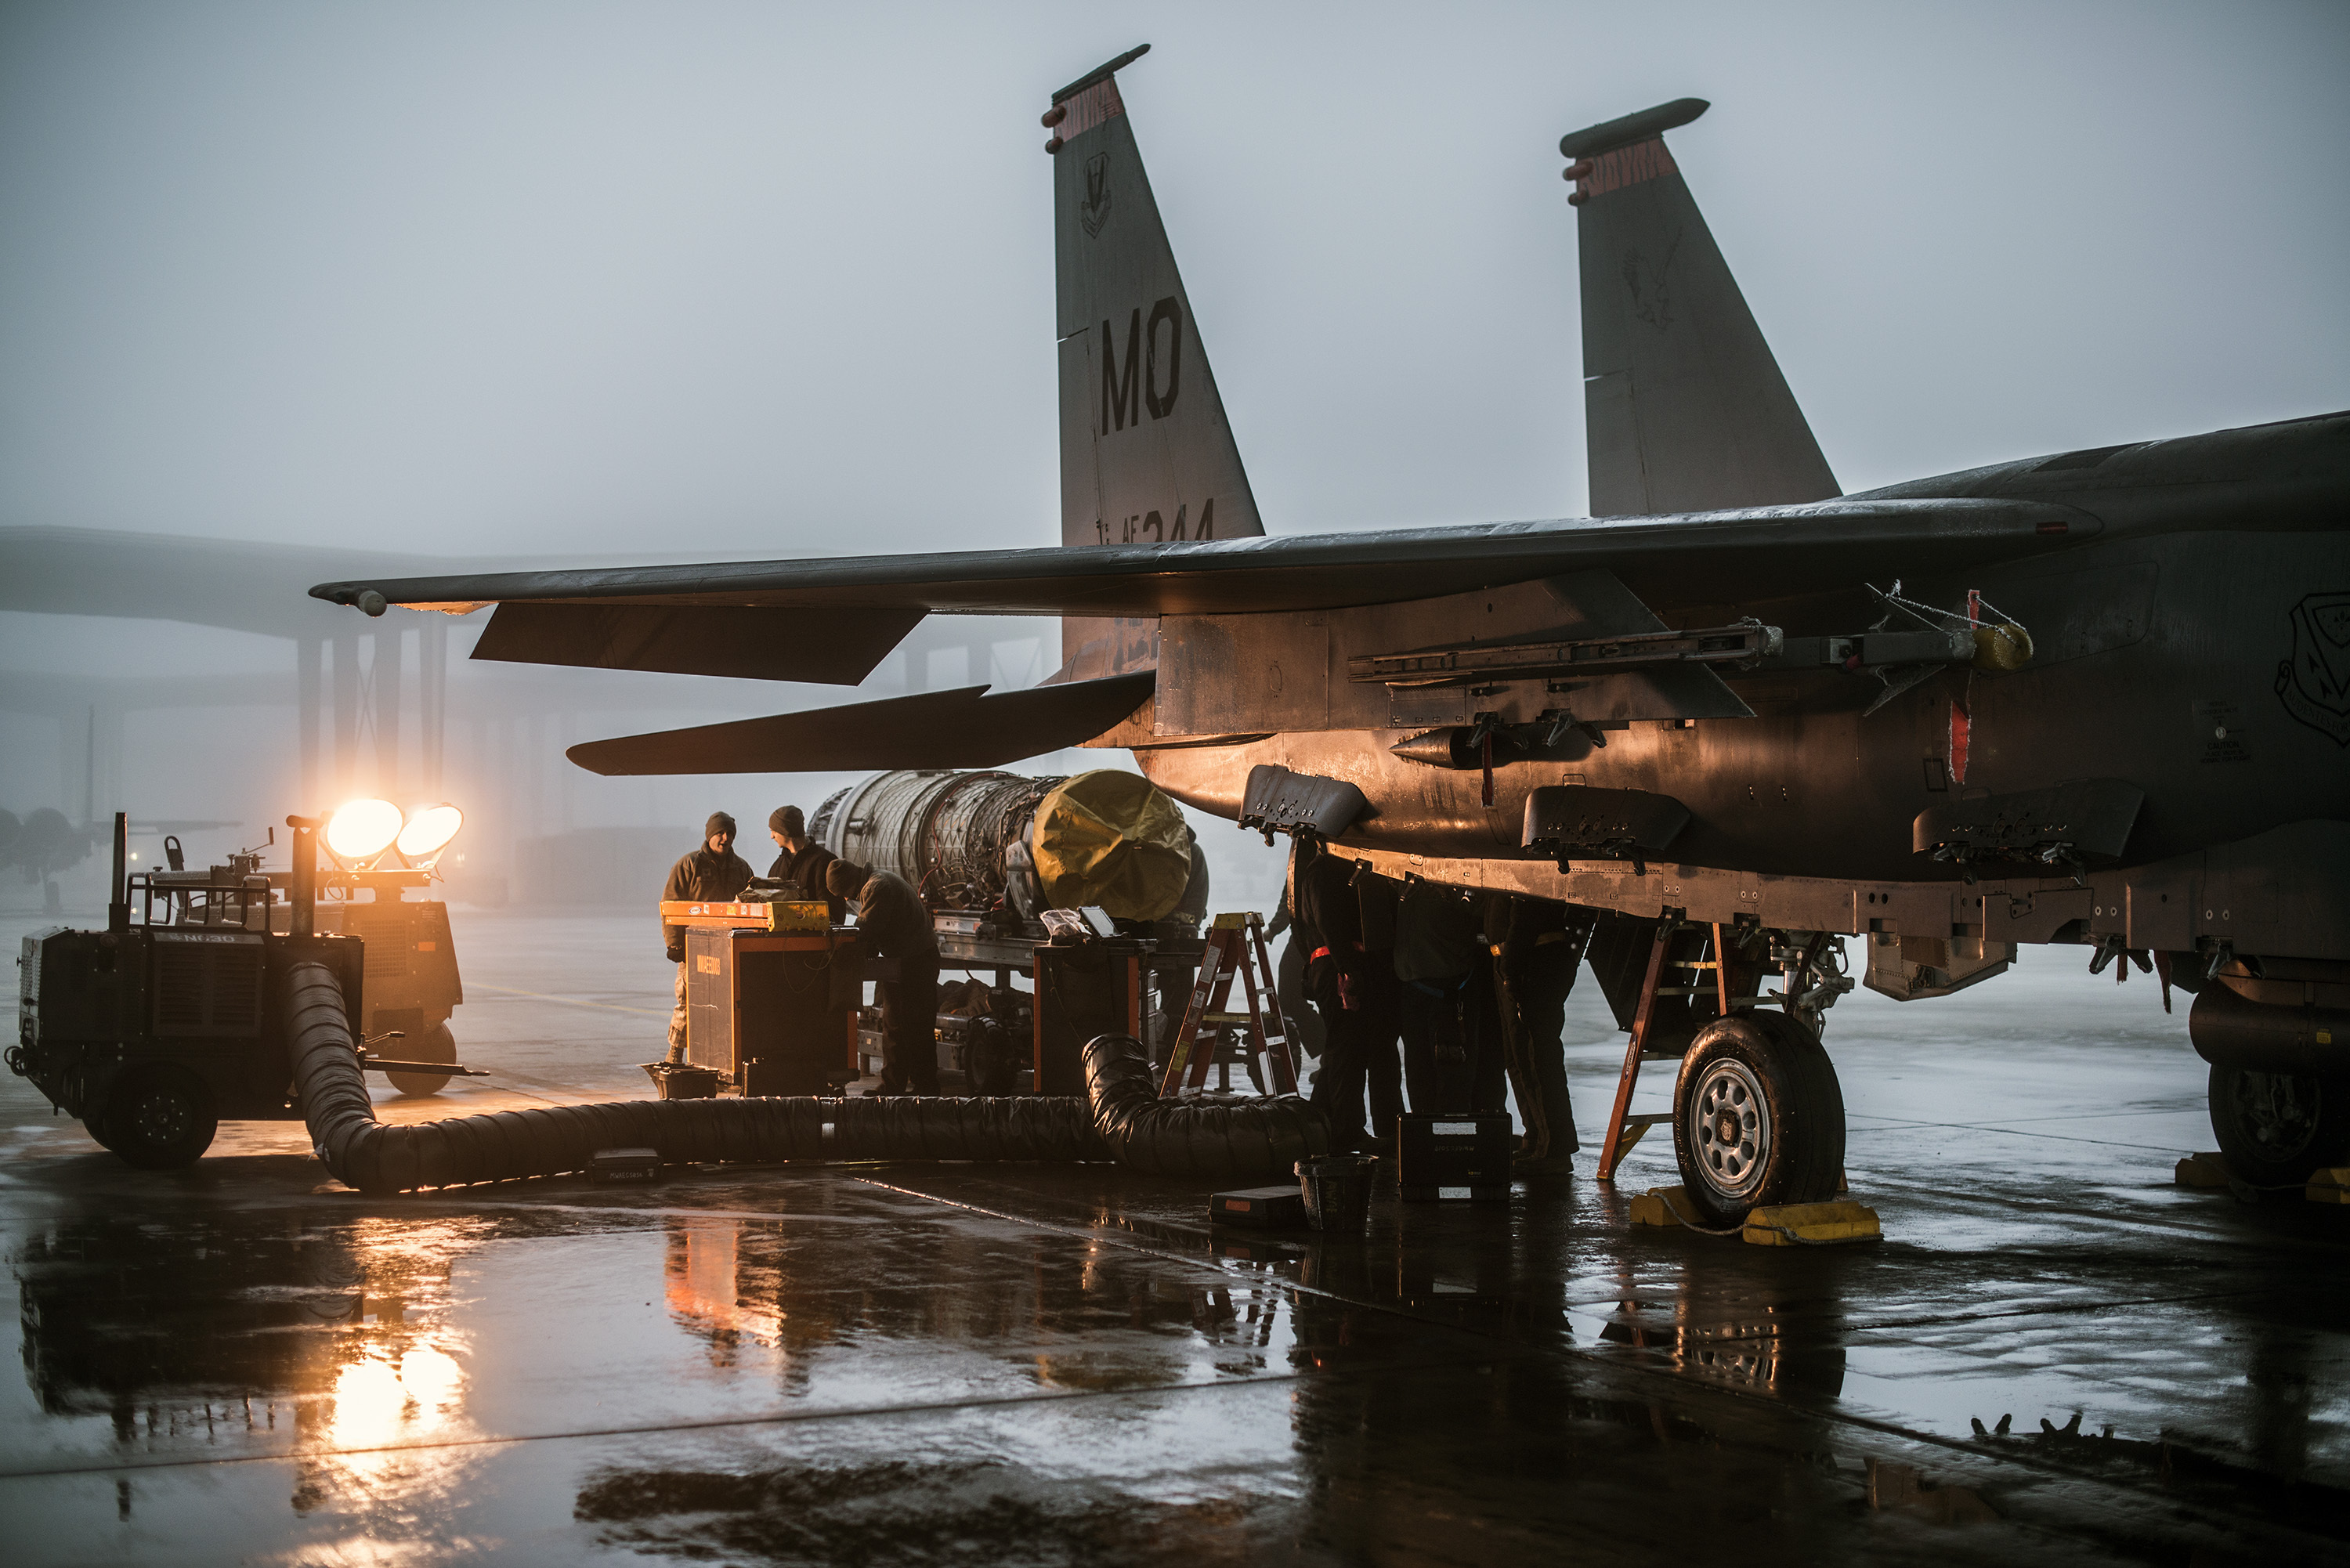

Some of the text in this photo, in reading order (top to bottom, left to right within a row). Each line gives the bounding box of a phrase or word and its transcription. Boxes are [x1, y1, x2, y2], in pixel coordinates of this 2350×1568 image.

[1101, 295, 1183, 436] MO
[1122, 515, 1139, 544] AF
[2286, 690, 2330, 728] AUDENTES
[2207, 740, 2240, 750] CAUTION
